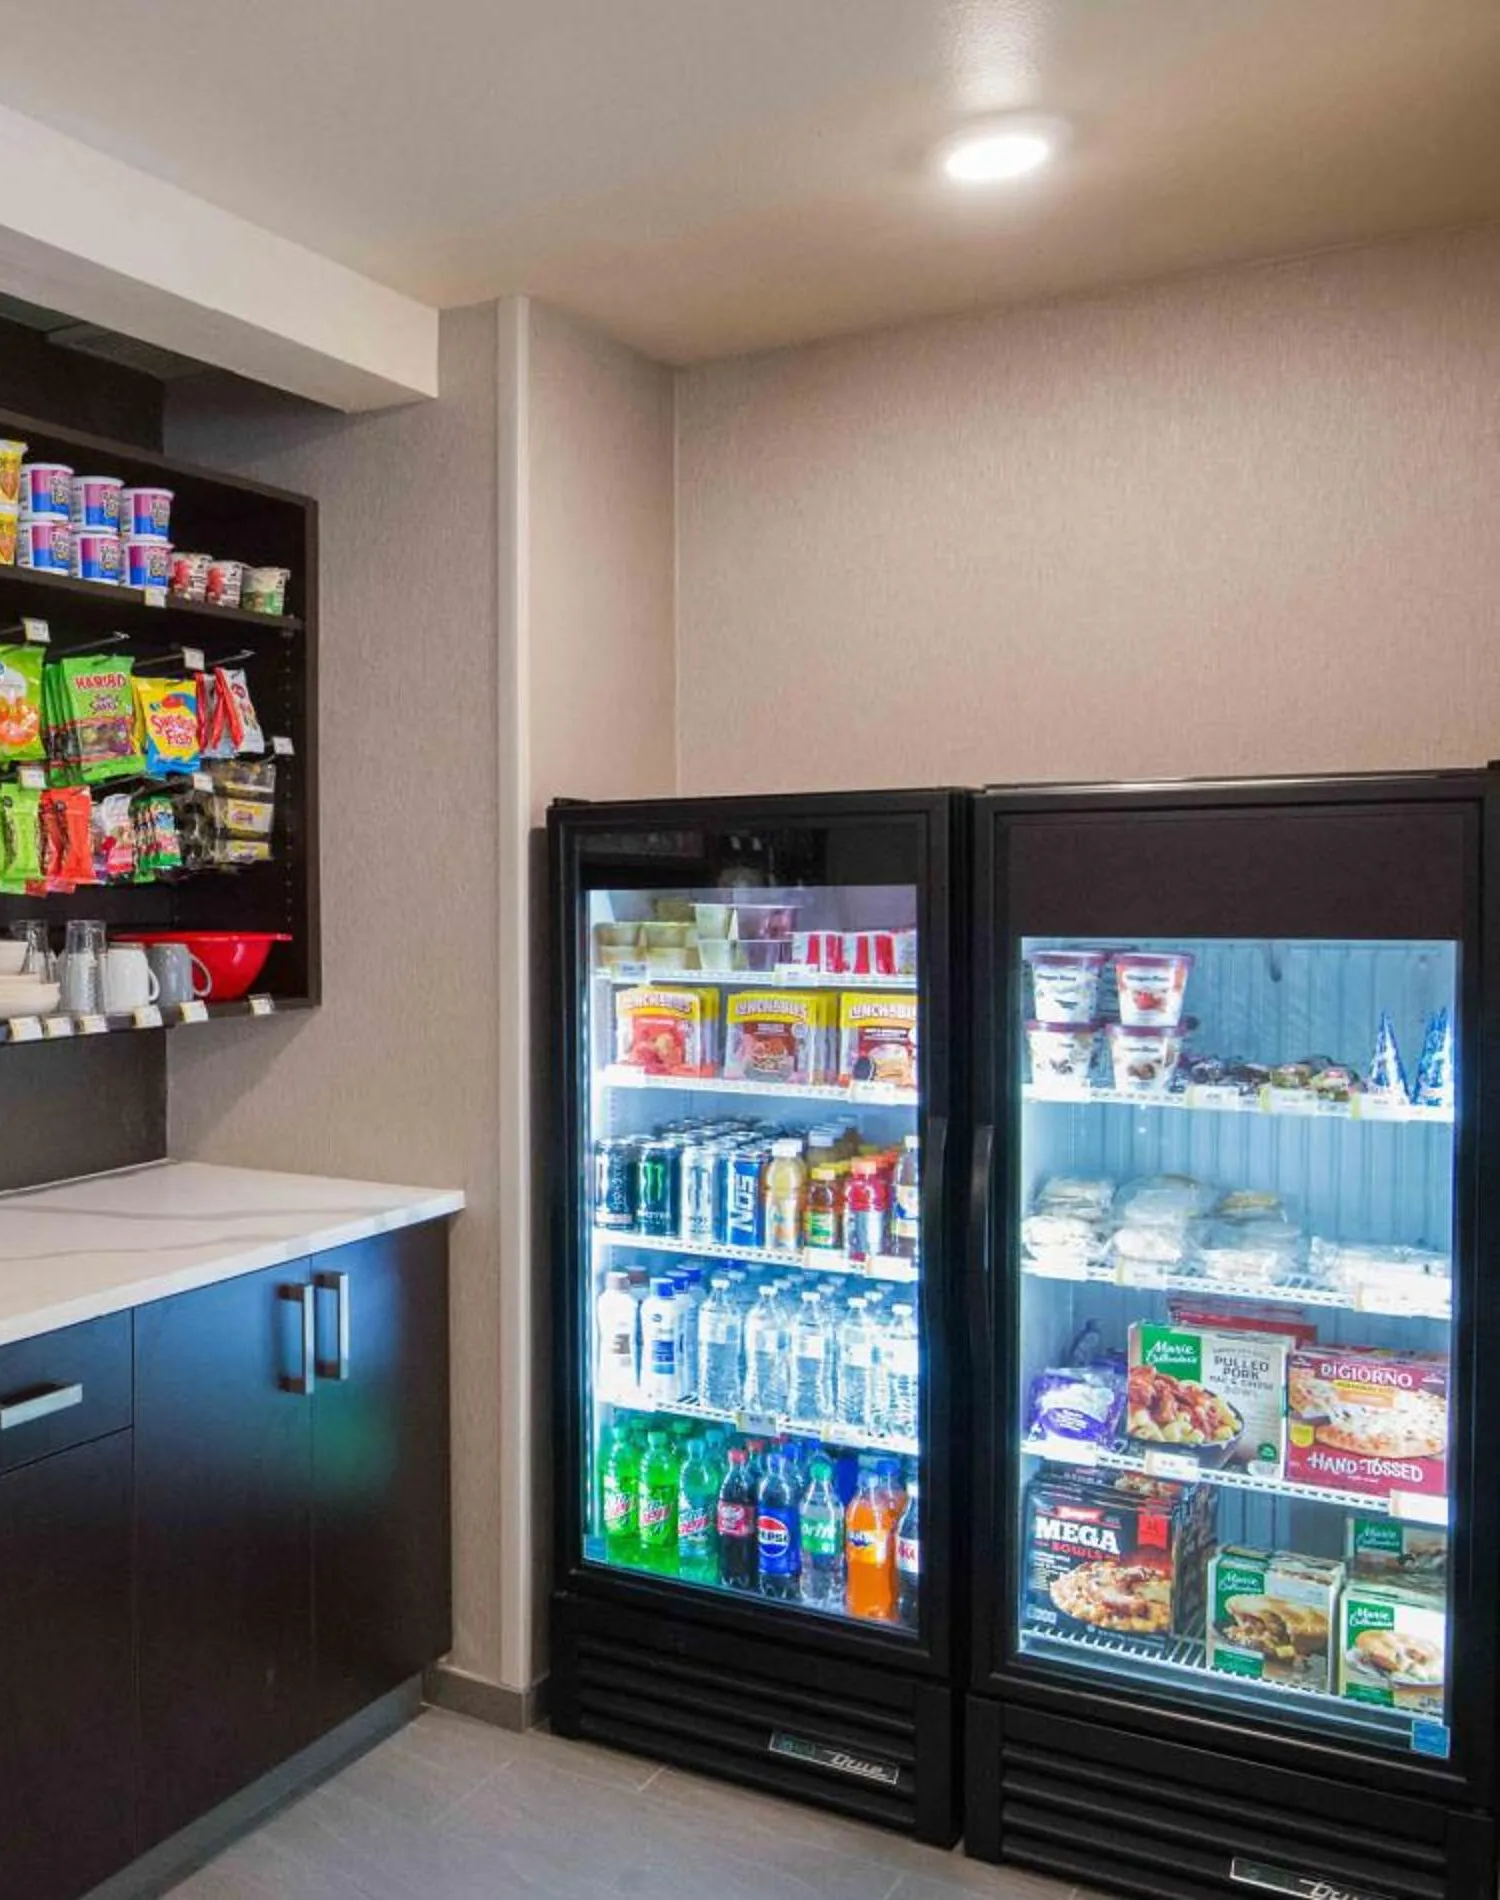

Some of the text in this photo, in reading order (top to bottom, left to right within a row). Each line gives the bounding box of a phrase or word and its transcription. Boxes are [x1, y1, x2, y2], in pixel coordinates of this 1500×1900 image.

[852, 1003, 917, 1020] LUNCHABL
[1152, 1340, 1194, 1355] Marie
[1213, 1355, 1270, 1372] PULLED
[1033, 1514, 1121, 1555] MEGA
